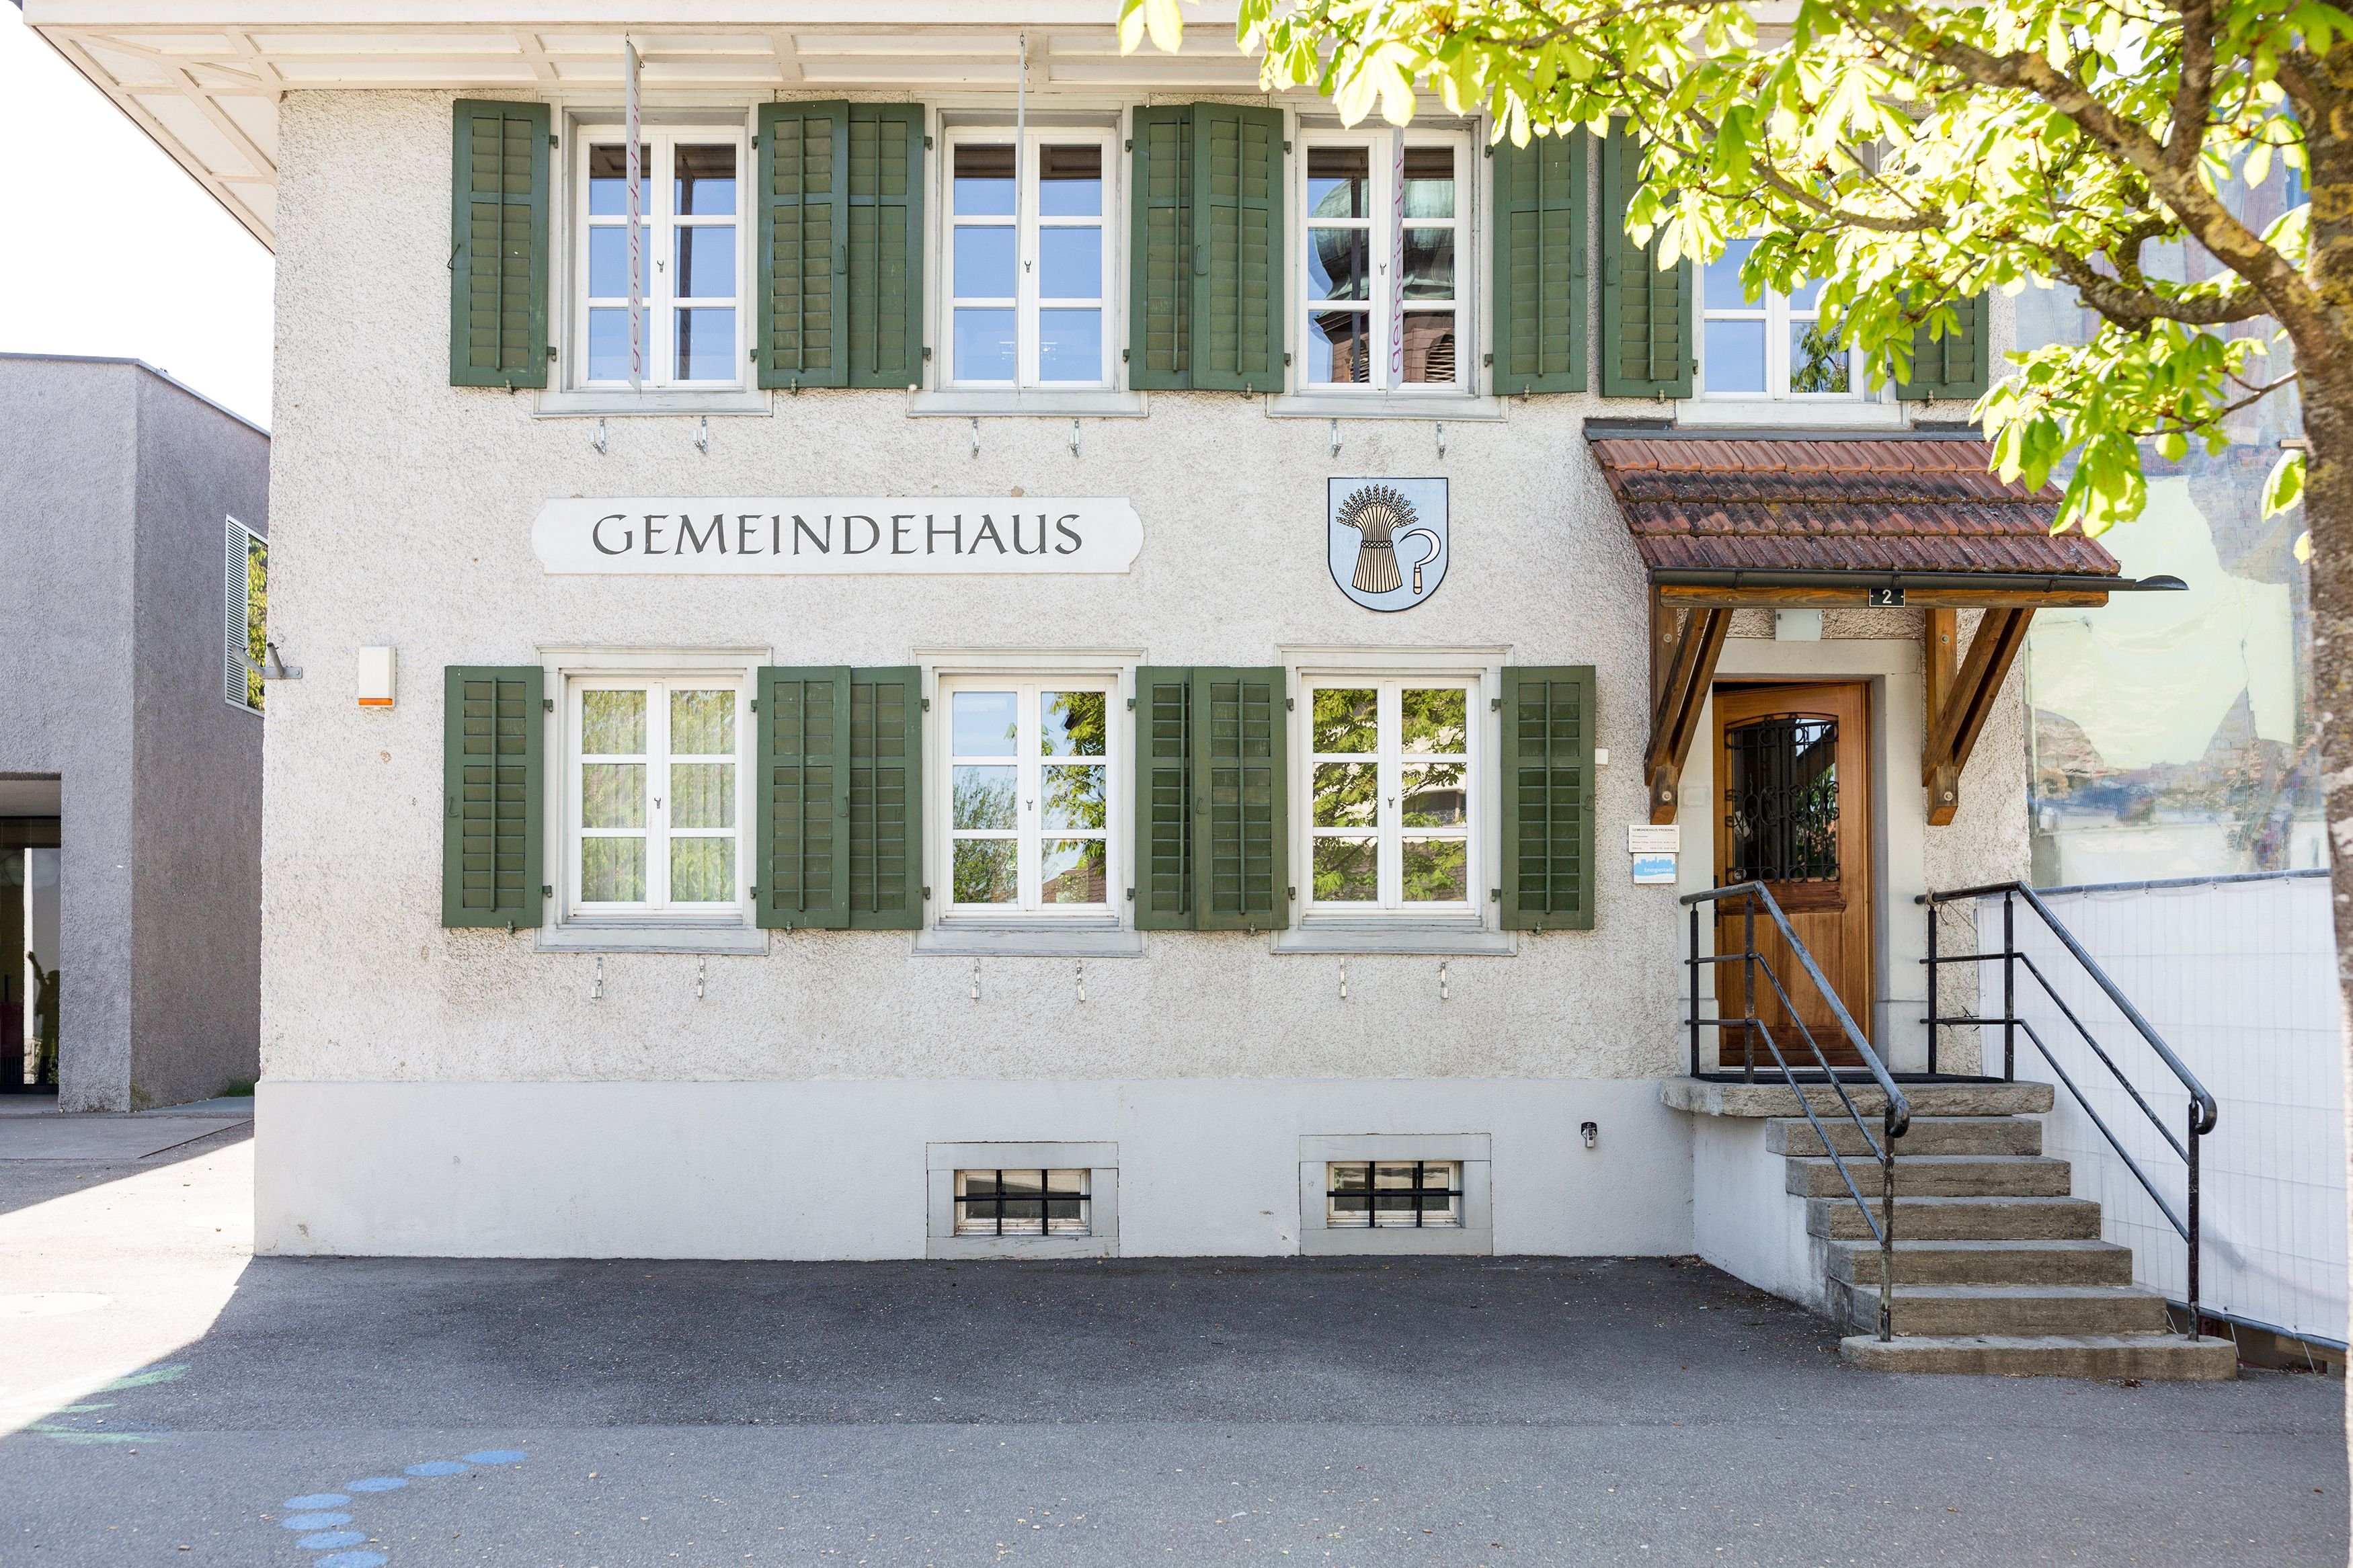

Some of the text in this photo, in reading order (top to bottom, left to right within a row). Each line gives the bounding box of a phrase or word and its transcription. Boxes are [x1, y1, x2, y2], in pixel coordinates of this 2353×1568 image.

[629, 70, 641, 374] gemeindehaus
[1392, 126, 1403, 374] gemeindeh
[593, 513, 1082, 555] GEMEINDEHAUS
[1882, 589, 1892, 604] 2
